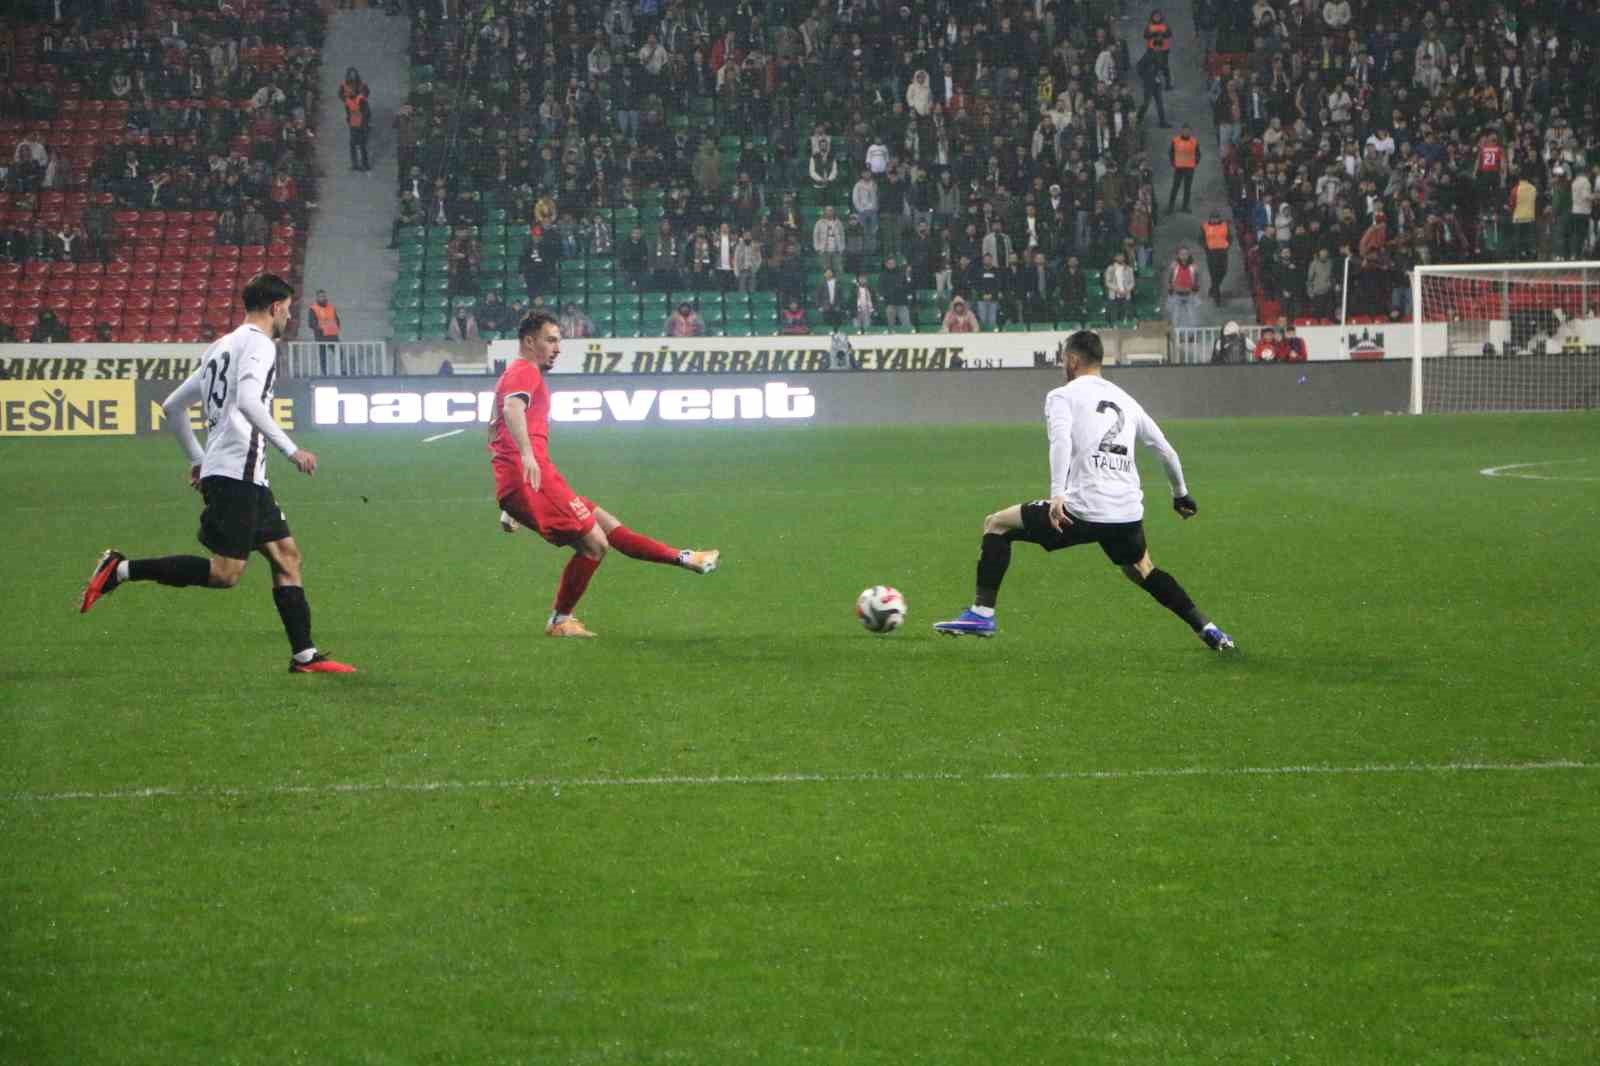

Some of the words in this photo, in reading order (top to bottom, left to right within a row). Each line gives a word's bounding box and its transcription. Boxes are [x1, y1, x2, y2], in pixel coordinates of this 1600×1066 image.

[0, 357, 84, 380] AKIR
[95, 357, 202, 380] SEYAH
[0, 388, 118, 431] ESİNE
[549, 382, 815, 422] event
[1096, 400, 1128, 455] 2
